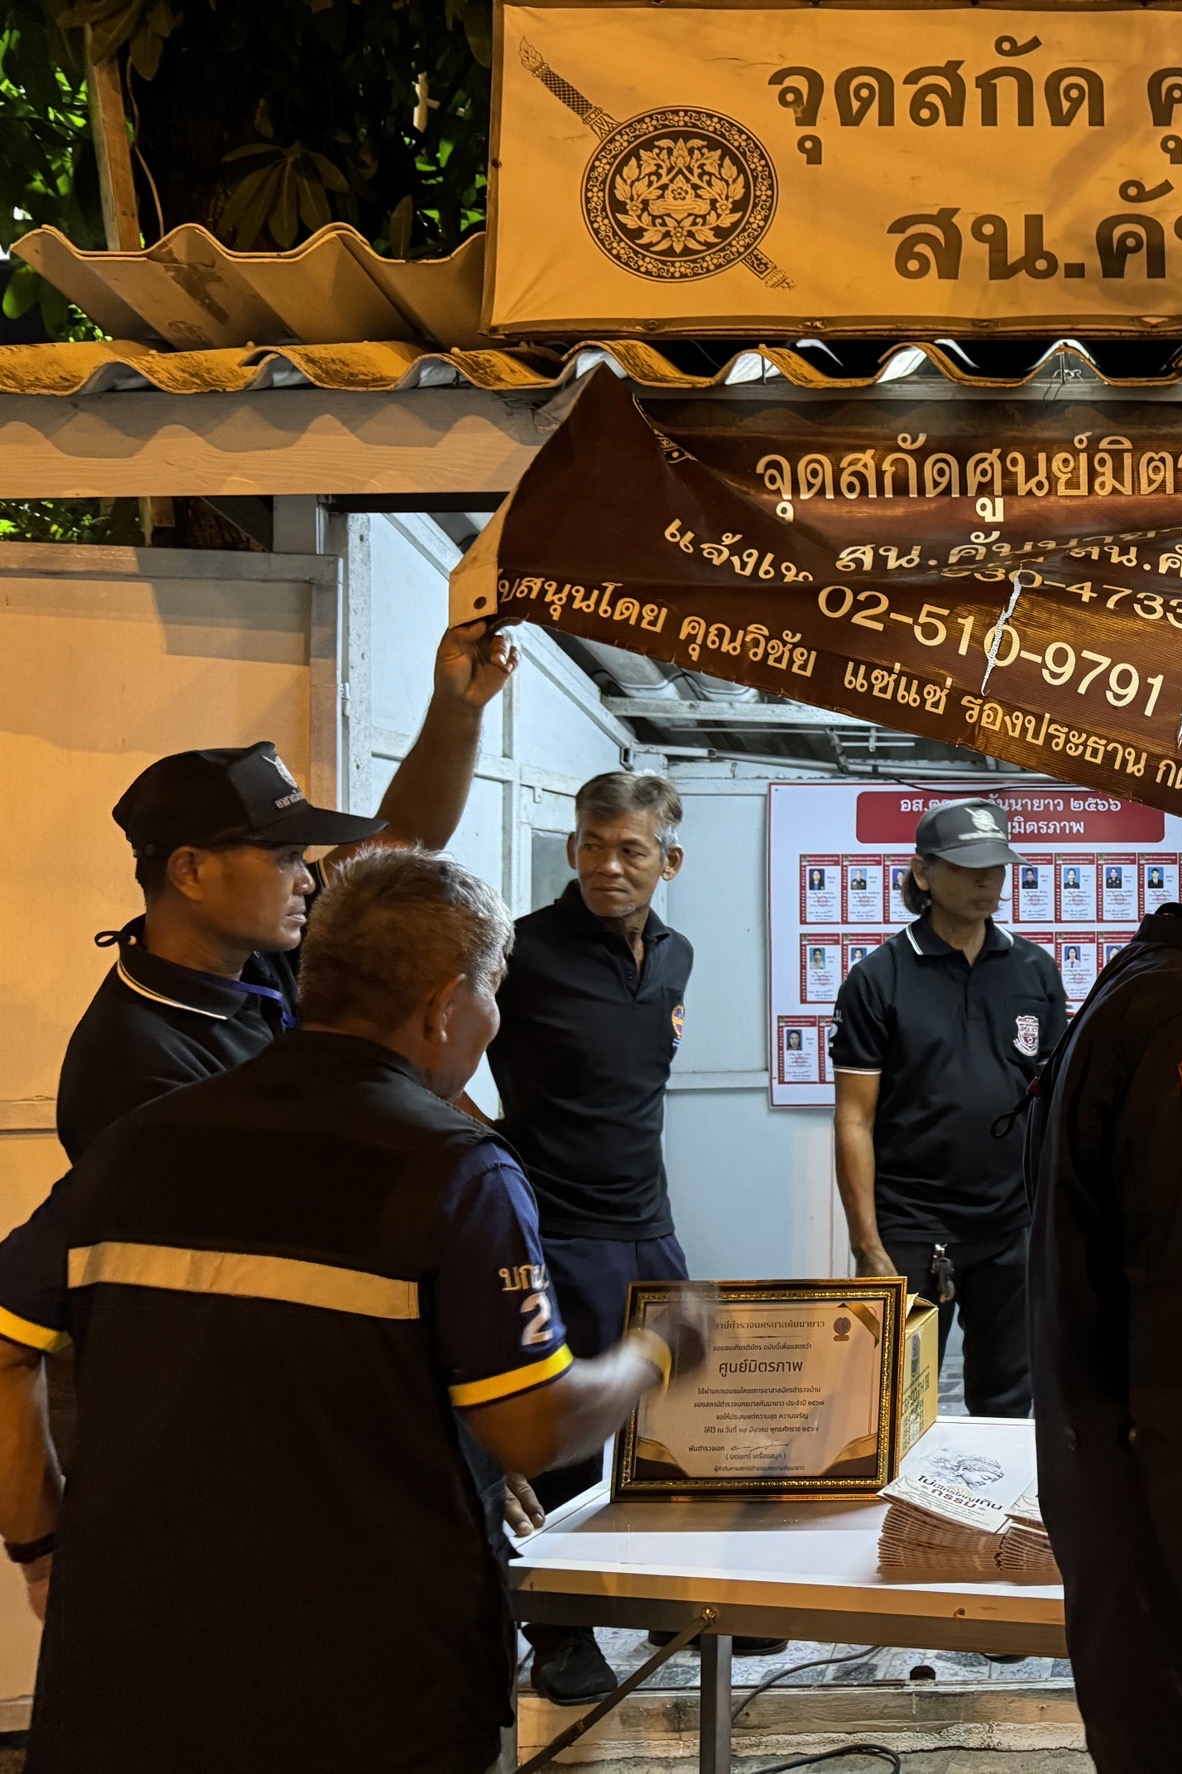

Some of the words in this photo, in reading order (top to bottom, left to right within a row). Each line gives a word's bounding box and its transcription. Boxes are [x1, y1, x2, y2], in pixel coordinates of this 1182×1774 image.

[767, 35, 1105, 165] จุดสกัด
[817, 585, 1165, 718] 02-510-9791
[679, 615, 817, 677] คุณวิชัย
[960, 695, 1147, 777] รองประธาน
[1069, 797, 1122, 812] ๒๕๖๖
[520, 1291, 554, 1347] 2
[719, 1358, 803, 1378] ศูนย์มิตรภาพ
[931, 1488, 976, 1509] กรรม
